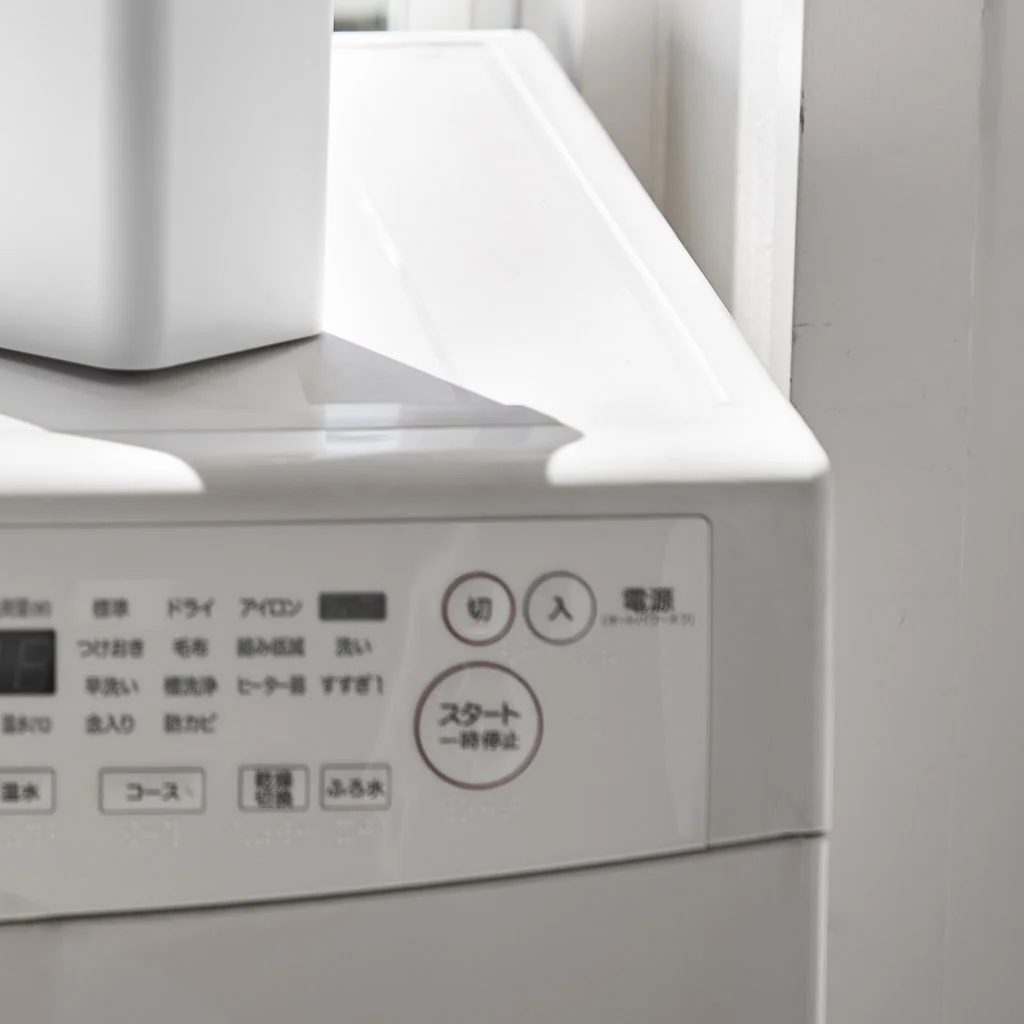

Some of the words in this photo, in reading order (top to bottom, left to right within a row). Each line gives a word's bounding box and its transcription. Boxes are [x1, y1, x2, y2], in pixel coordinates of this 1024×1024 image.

[168, 598, 214, 618] ドライ
[241, 598, 303, 617] アイロン
[466, 596, 492, 622] 切
[548, 595, 572, 621] 入
[622, 587, 674, 611] 電源
[336, 637, 372, 657] 洗い
[439, 702, 520, 727] スタート
[440, 730, 517, 750] 一時停止
[0, 782, 39, 802] 温水
[127, 782, 180, 801] コース
[326, 778, 383, 798] ふろ水
